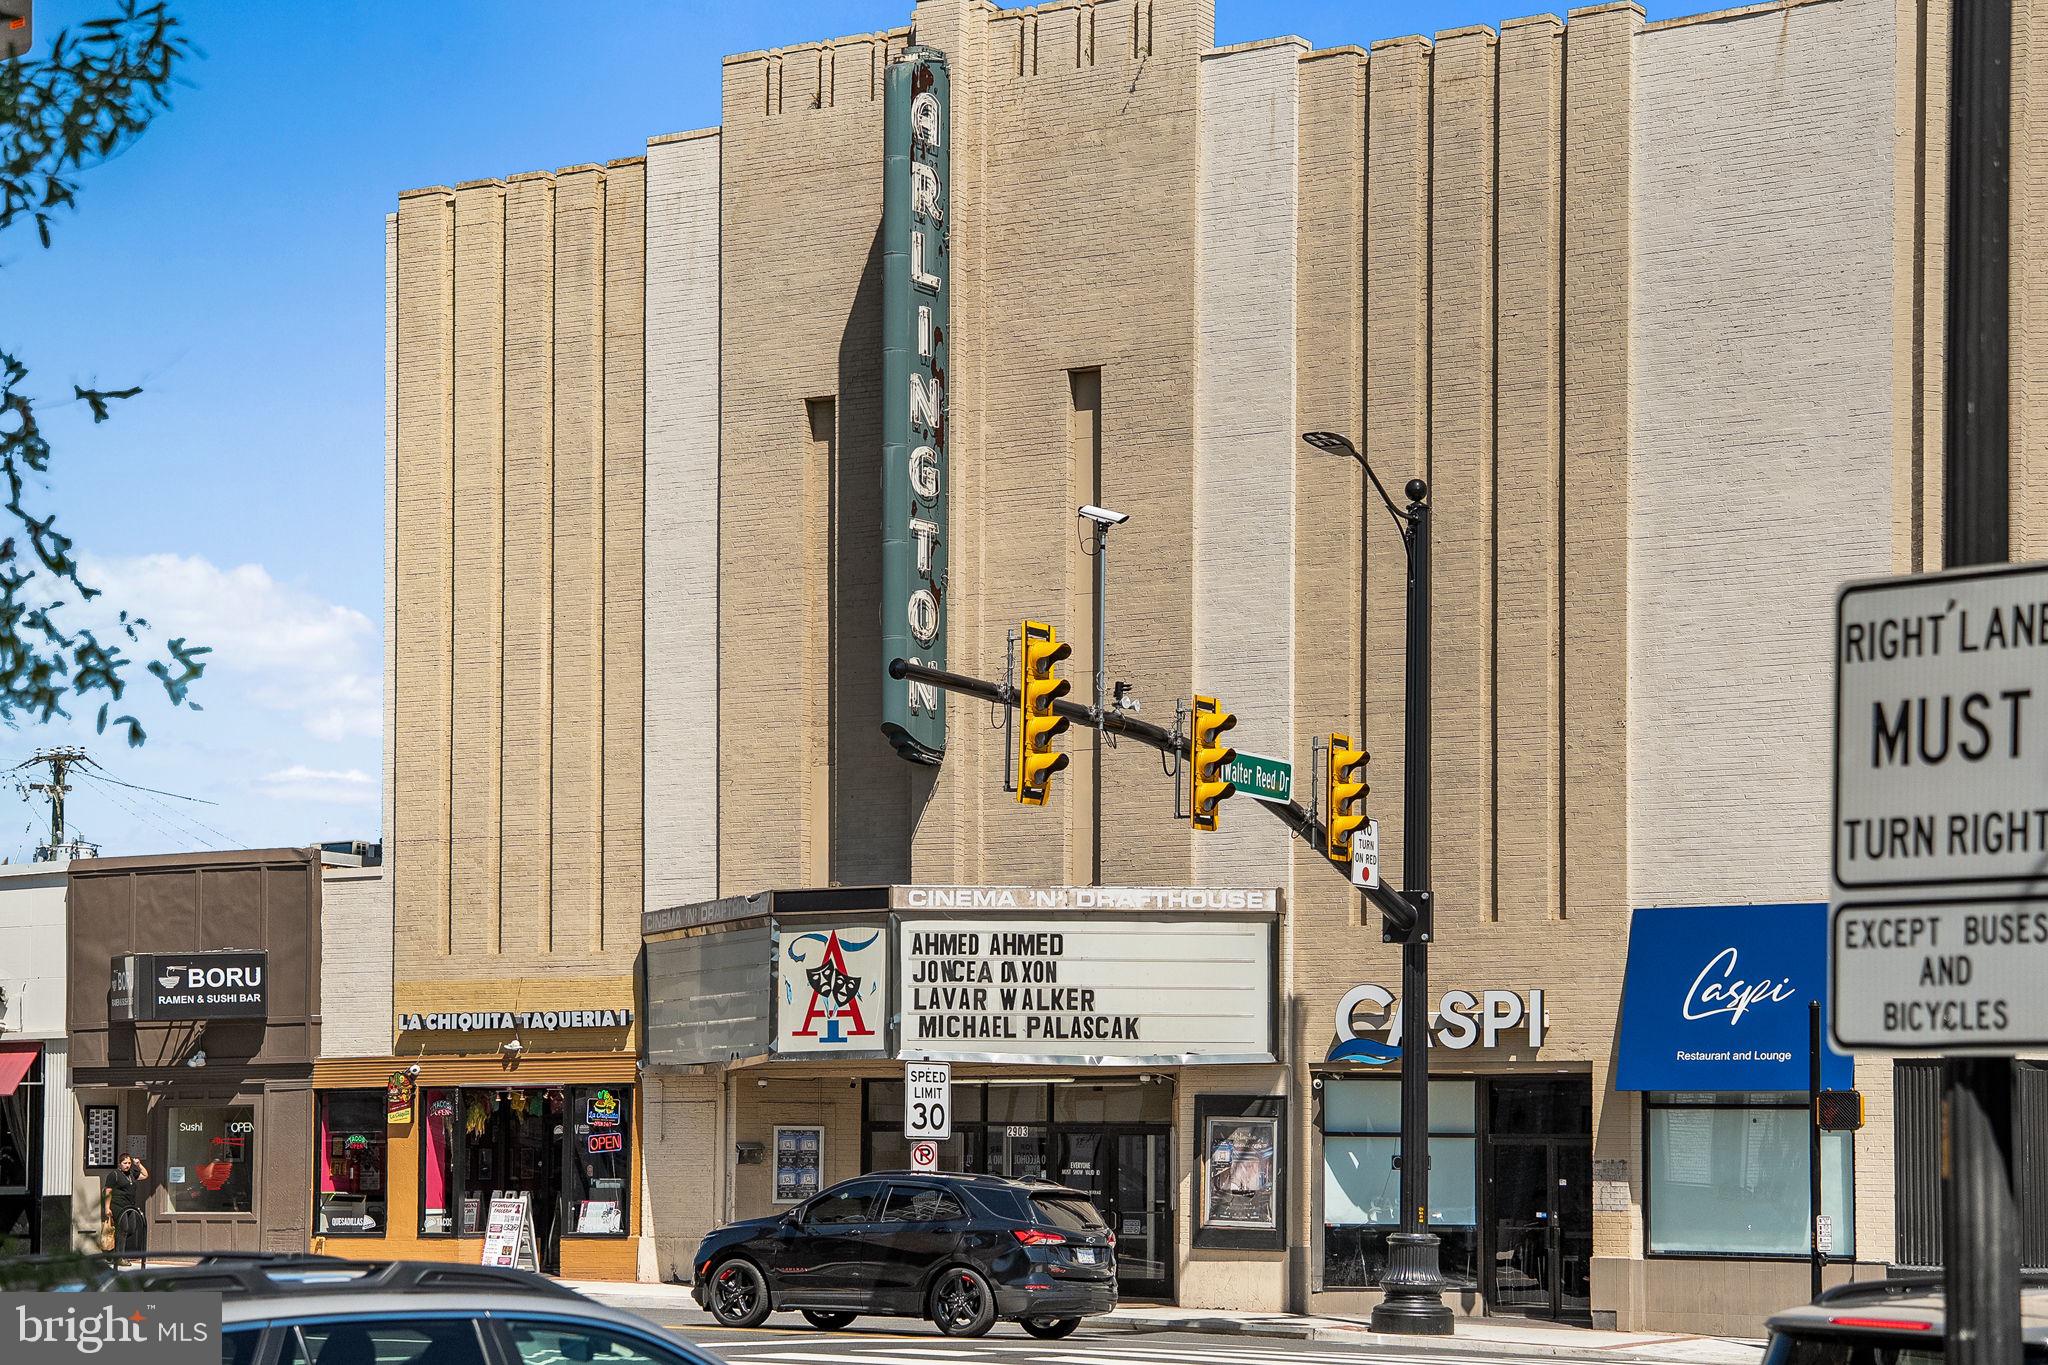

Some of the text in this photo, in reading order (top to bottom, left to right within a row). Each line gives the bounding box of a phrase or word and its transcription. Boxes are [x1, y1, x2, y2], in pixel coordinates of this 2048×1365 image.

[909, 91, 944, 713] ARLINGTON
[1845, 613, 1944, 663] RIGHT
[1871, 690, 2032, 769] MUST
[1225, 762, 1290, 793] Walter Reed Dr
[1359, 838, 1375, 850] TURN
[1844, 810, 2048, 862] TURN RIGHT
[1355, 852, 1377, 866] ON RED
[908, 890, 1016, 907] CINEMA
[1076, 890, 1263, 909] DRAFTHOUSE
[647, 911, 682, 930] CINEMA
[1845, 912, 2048, 949] EXCEPT BUSES
[912, 933, 1063, 956] AHMED AHMED
[188, 967, 261, 989] BORU
[912, 960, 1057, 983] JONCEA DIXON
[1919, 954, 1973, 987] AND
[1683, 947, 1795, 1026] Caspi
[158, 993, 261, 1005] RAMEN & SUSHI BAR
[914, 987, 1095, 1012] LAVAR WALKER
[398, 1014, 422, 1031] LA
[426, 1012, 515, 1032] CHIQUITA
[521, 1010, 616, 1032] TAQUERIA
[1884, 1000, 2009, 1032] BICYCLES
[918, 1015, 1140, 1040] MICHAEL PALASCAK
[1677, 1050, 1792, 1063] Restaurant and Lounge
[910, 1070, 946, 1083] SPEED
[914, 1086, 943, 1099] LIMIT
[180, 1122, 203, 1132] Sushi
[911, 1103, 945, 1130] 30
[590, 1136, 620, 1151] OPEN
[1007, 1128, 1028, 1137] 2903
[331, 1217, 364, 1226] QUESADILLAS
